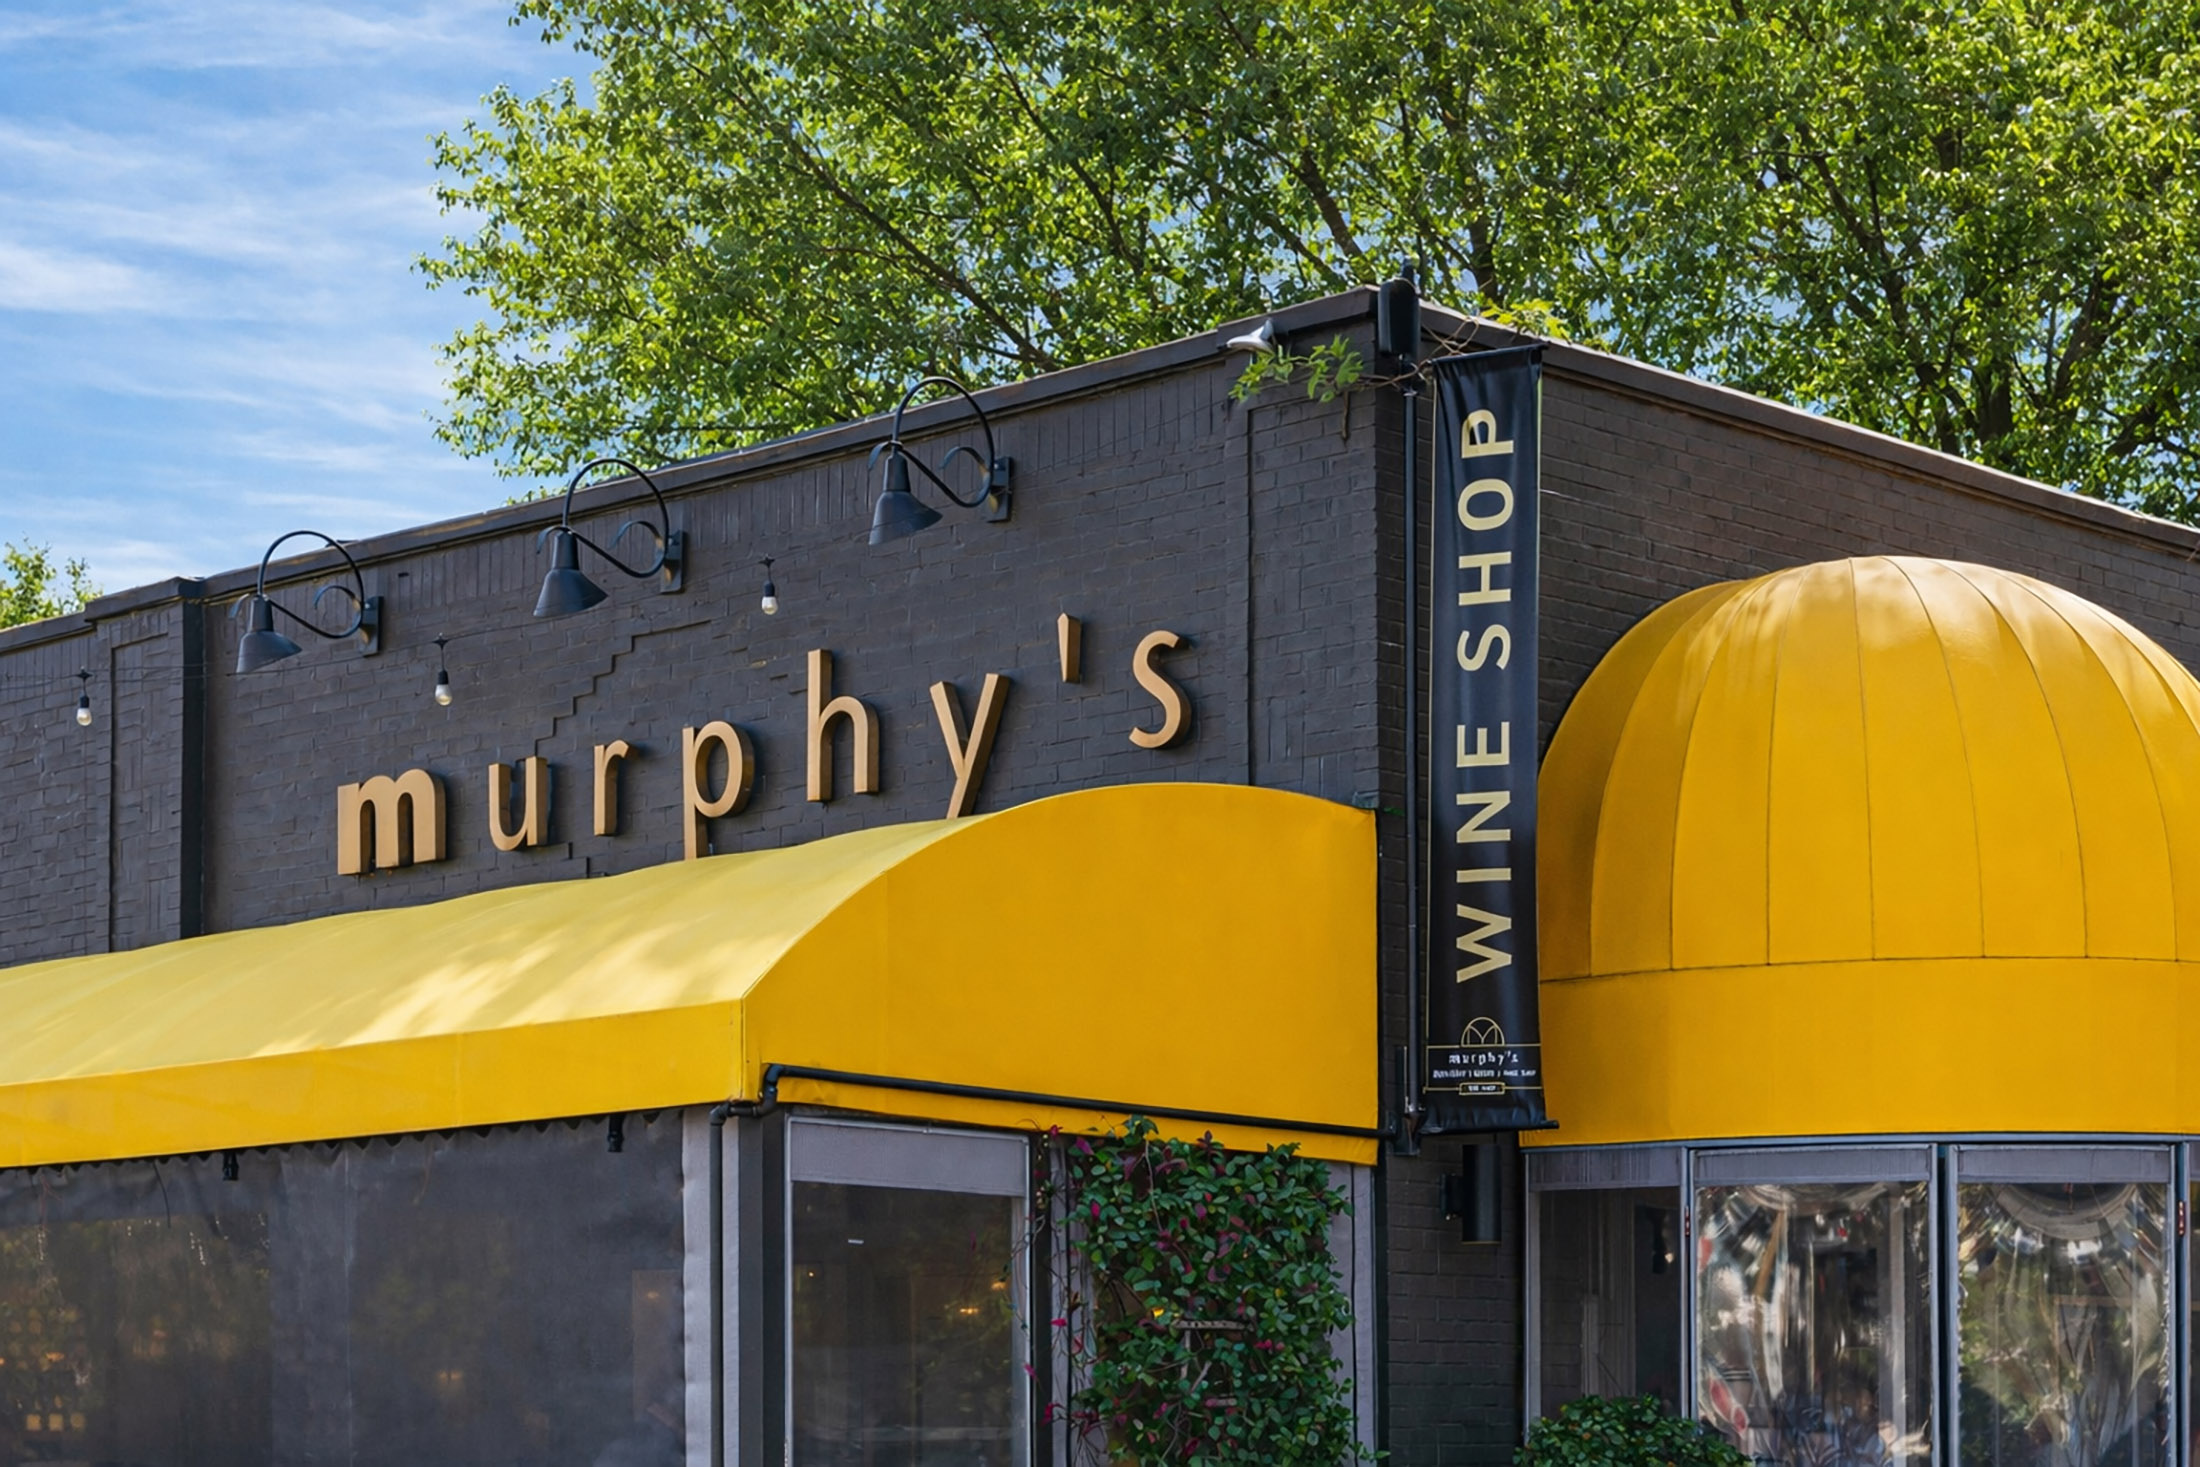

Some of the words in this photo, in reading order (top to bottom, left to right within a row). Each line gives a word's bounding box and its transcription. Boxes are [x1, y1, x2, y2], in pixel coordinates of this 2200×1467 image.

[1456, 408, 1514, 672] SHOP
[337, 613, 1191, 875] murphy's
[1456, 721, 1512, 983] WINE
